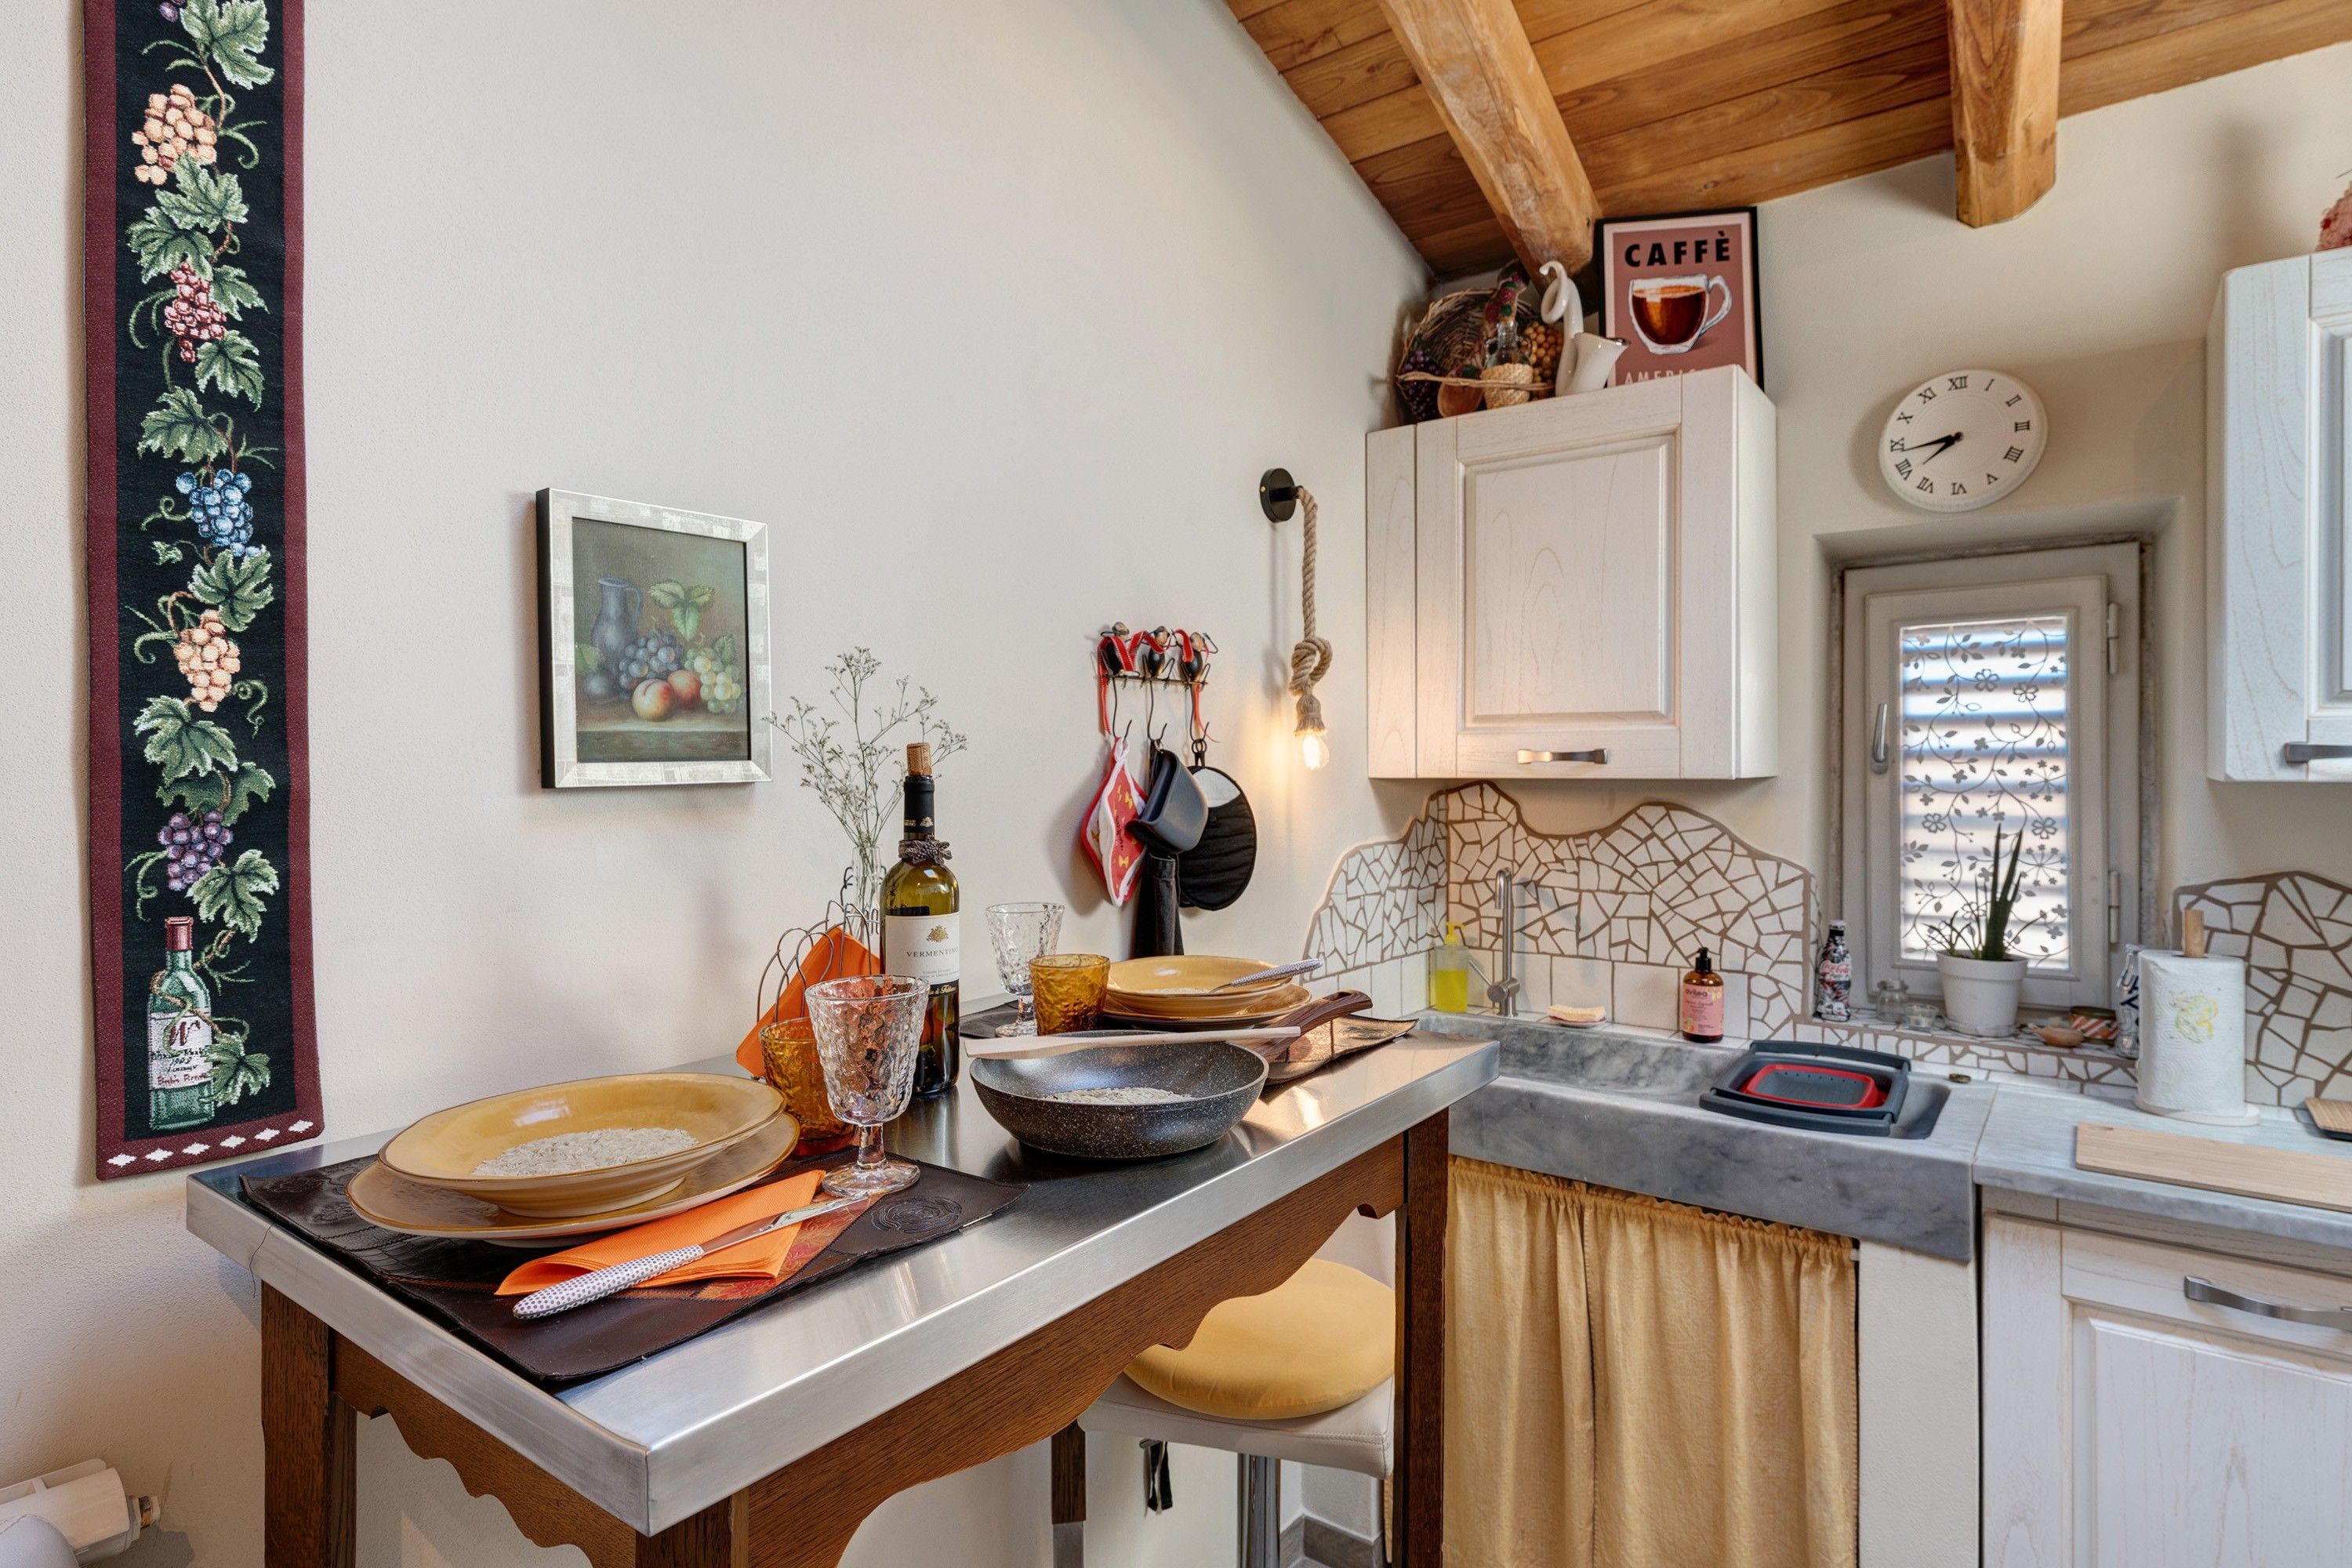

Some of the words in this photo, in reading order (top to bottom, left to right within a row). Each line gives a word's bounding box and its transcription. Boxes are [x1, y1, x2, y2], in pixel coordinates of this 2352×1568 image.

[1624, 230, 1731, 267] CAFFÈ
[1947, 375, 1969, 391] XII
[1984, 378, 1995, 392] I
[1917, 387, 1937, 405] XI
[2005, 394, 2023, 407] II
[1896, 412, 1914, 424] X
[2013, 420, 2031, 432] III
[1889, 437, 1905, 452] IX
[2002, 445, 2024, 463] IIII
[1894, 458, 1913, 481] VIII
[1916, 476, 1934, 494] VII
[1985, 472, 1999, 485] V
[1951, 482, 1968, 495] VI
